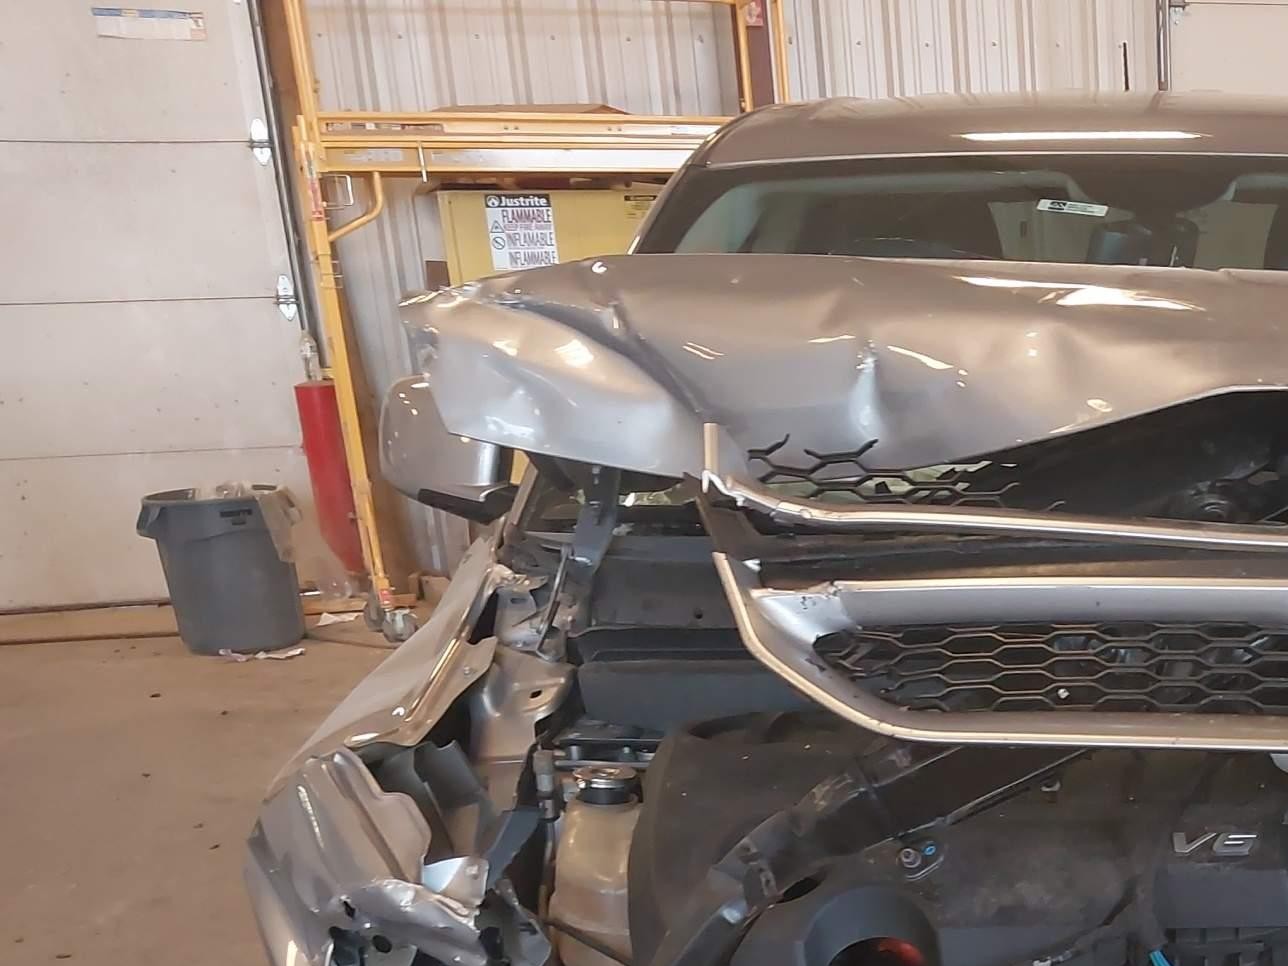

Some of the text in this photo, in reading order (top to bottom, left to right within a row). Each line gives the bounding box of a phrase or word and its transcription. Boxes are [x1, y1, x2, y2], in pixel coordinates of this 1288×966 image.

[500, 195, 548, 207] Justrite
[502, 209, 552, 223] FLAMMABLE
[1172, 832, 1257, 857] V6
